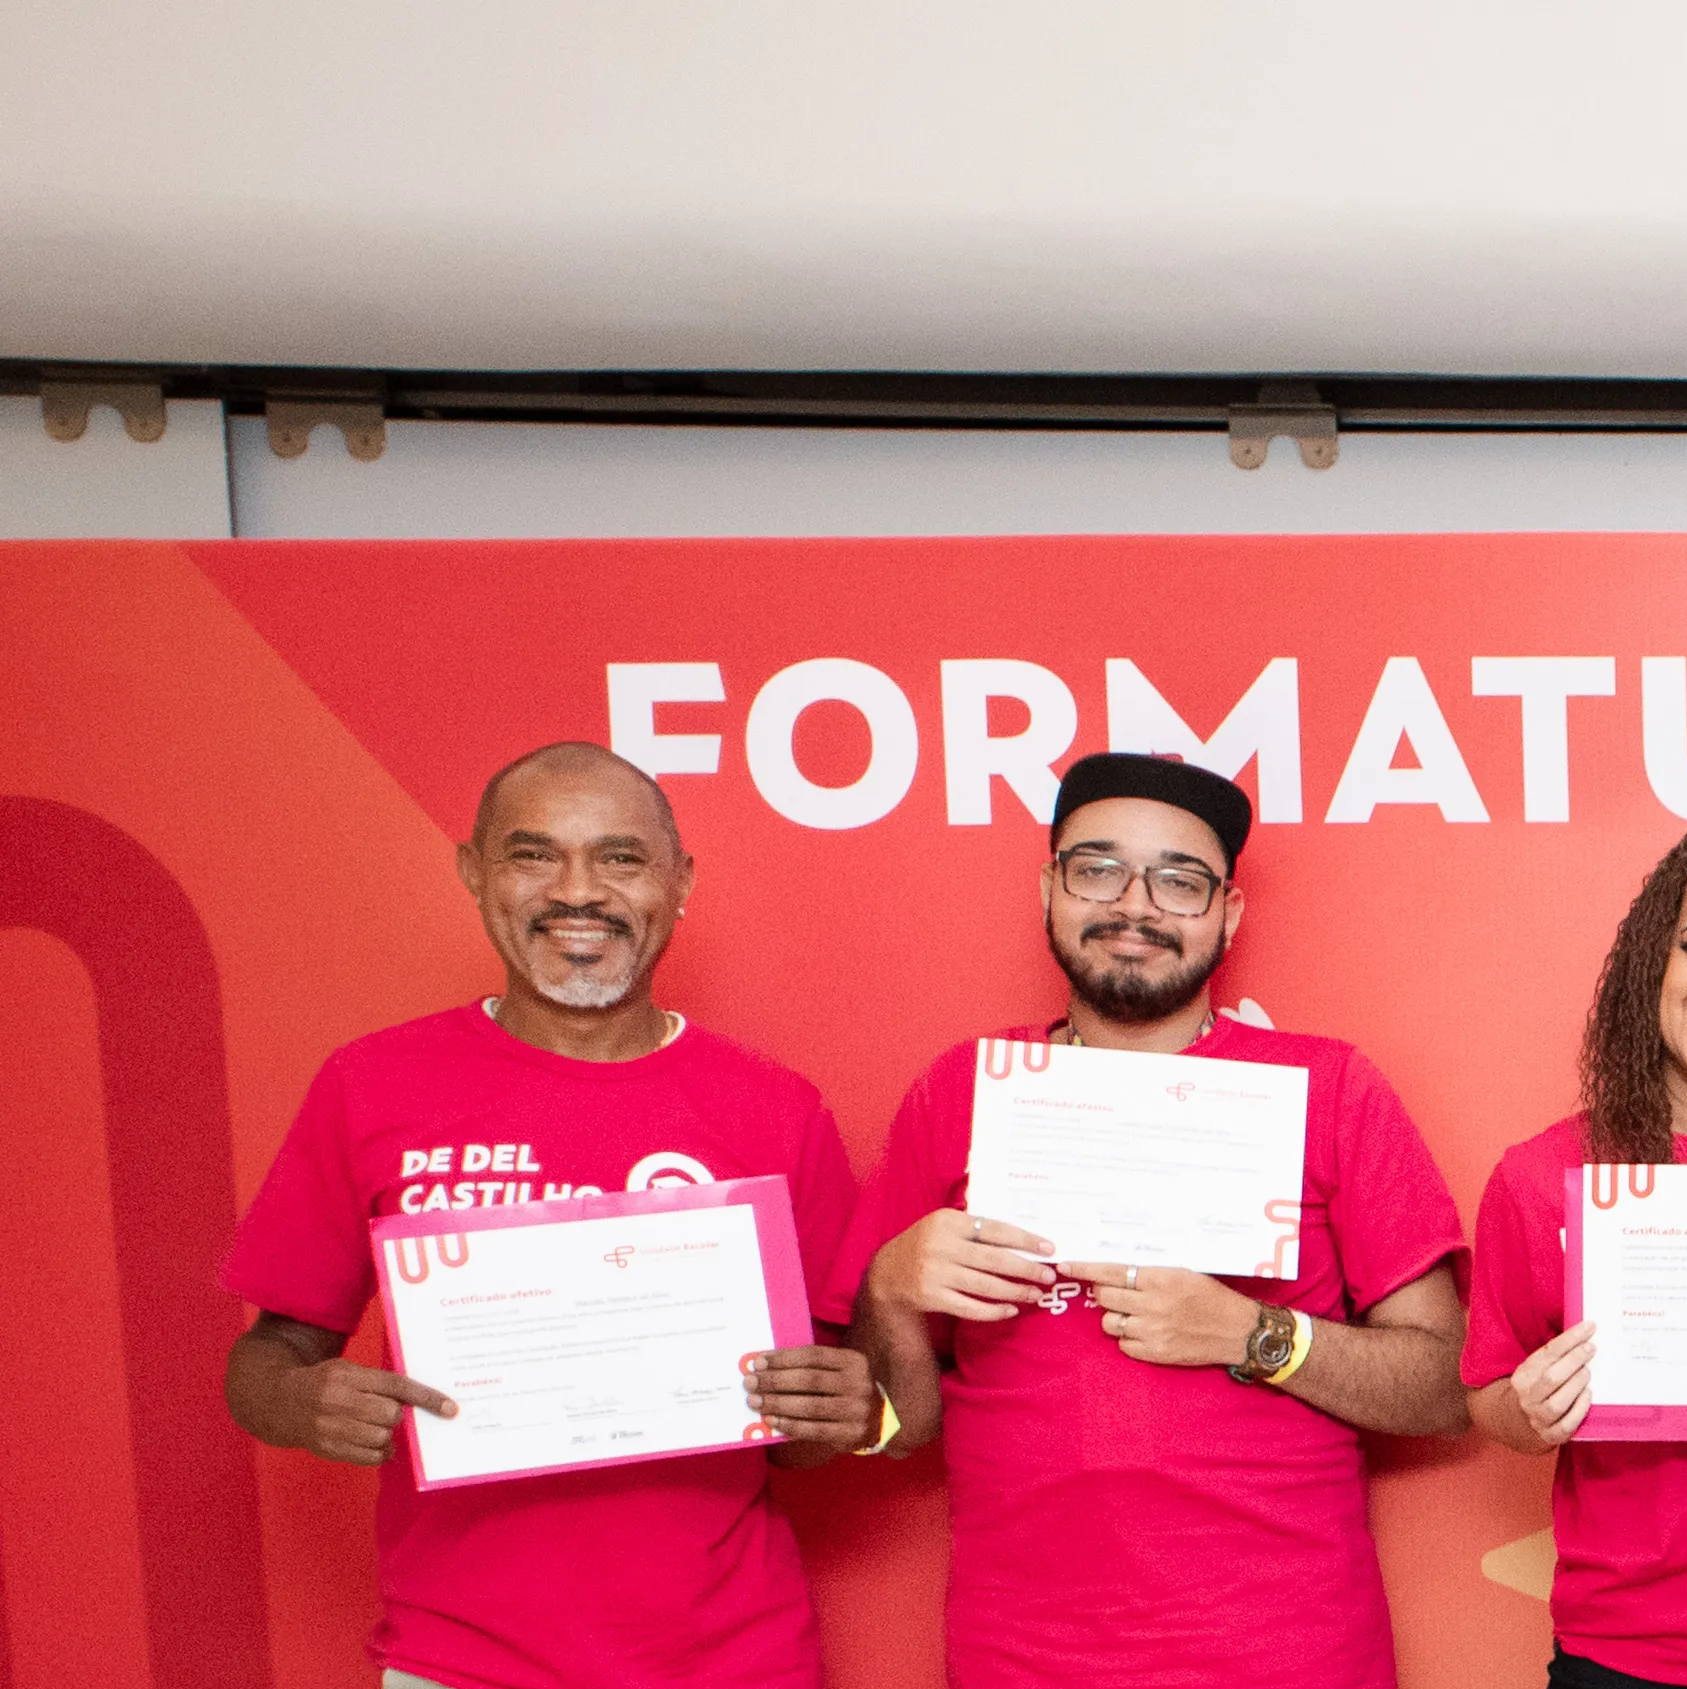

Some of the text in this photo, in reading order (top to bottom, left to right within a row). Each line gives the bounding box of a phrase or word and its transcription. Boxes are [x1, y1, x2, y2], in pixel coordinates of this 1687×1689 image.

[401, 1144, 540, 1178] DE DEL
[1622, 1226, 1682, 1237] Certificado
